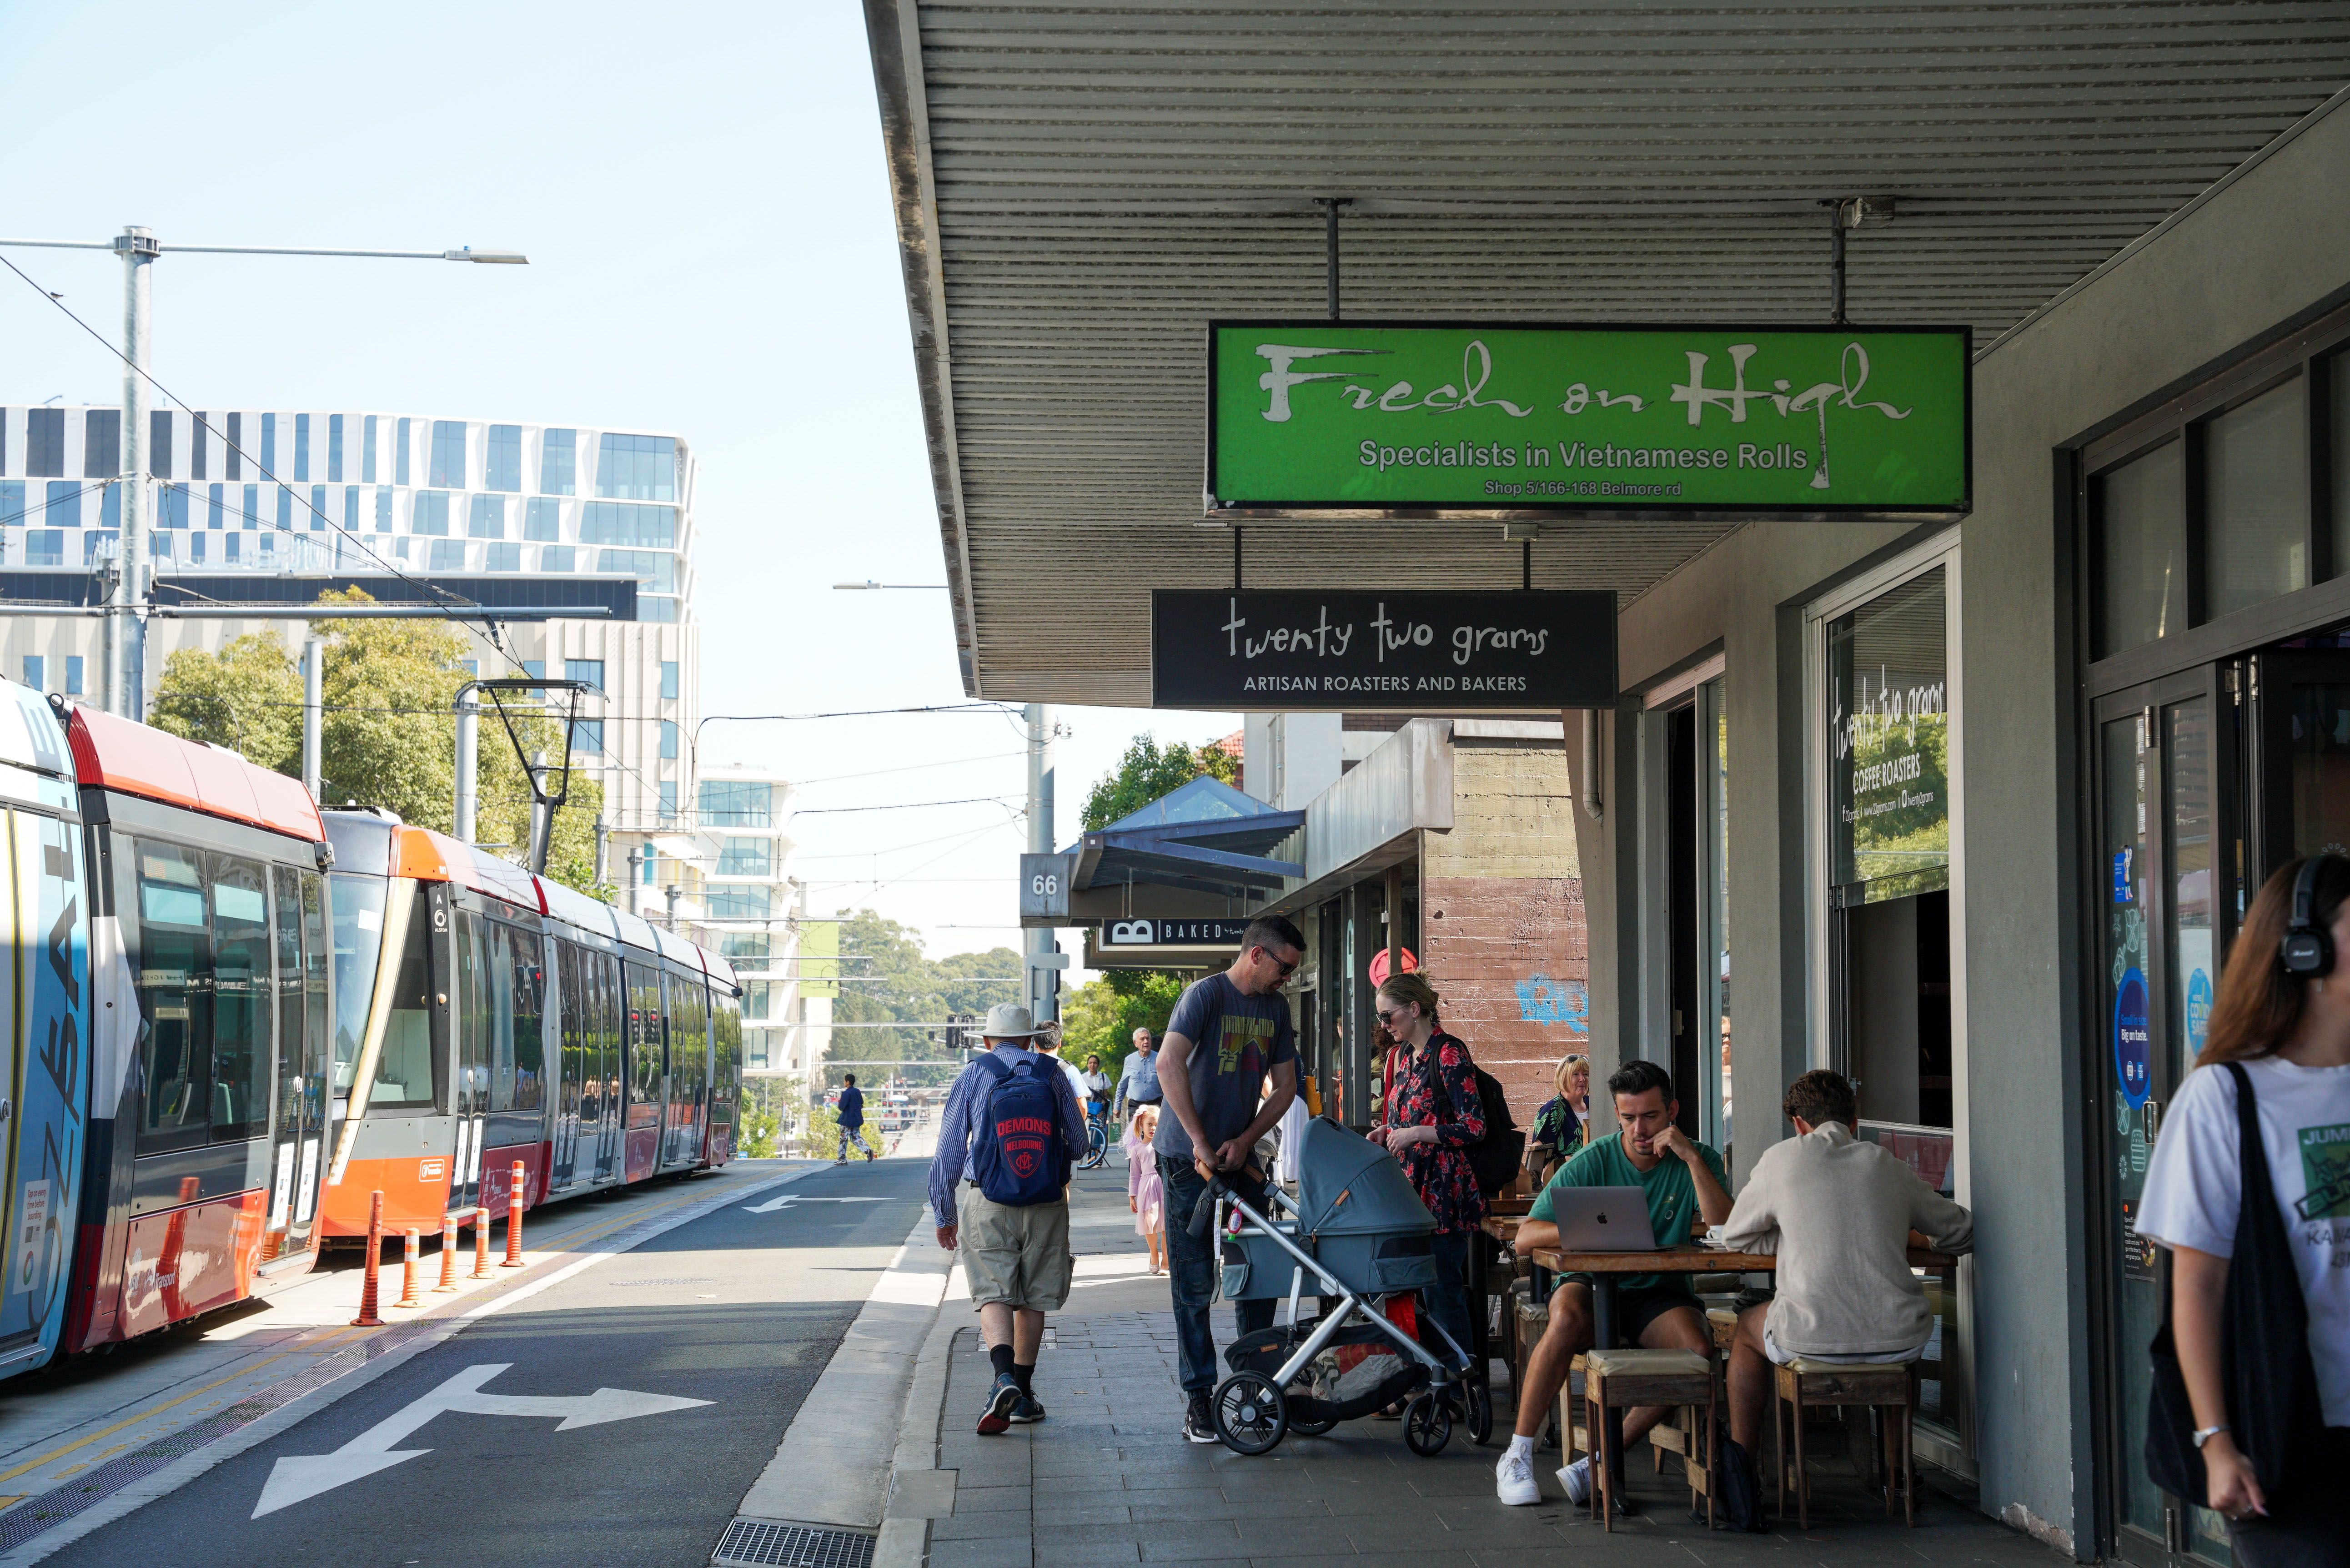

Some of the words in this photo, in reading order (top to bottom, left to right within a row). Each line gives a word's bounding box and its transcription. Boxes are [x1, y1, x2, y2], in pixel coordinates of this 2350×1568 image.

[1557, 382, 1654, 415] on
[1670, 342, 1913, 489] High
[1359, 440, 1517, 472] Specialists
[1526, 441, 1550, 469] in
[1558, 442, 1728, 470] Vietnamese
[1737, 442, 1808, 470] Rolls
[1485, 480, 1522, 497] Shop
[1525, 480, 1597, 494] 5/166-168
[1601, 481, 1662, 496] Belmore
[1666, 481, 1682, 496] rd
[1221, 597, 1353, 659] twenty
[1370, 602, 1434, 663] two
[1452, 625, 1548, 665] grams
[1243, 676, 1316, 691] ARTISAN
[1324, 676, 1410, 691] ROASTERS
[1416, 676, 1455, 691] AND
[1462, 676, 1526, 691] BAKERS
[1833, 676, 1874, 760] twenty
[1879, 663, 1902, 752] two
[1907, 682, 1943, 747] grams
[1853, 764, 1880, 795] COFFEE
[1882, 752, 1920, 787] ROASTERS
[1908, 791, 1933, 807] twenty2grams
[1032, 874, 1057, 895] 66
[436, 894, 442, 904] A
[1165, 925, 1221, 938] BAKED
[2189, 1002, 2211, 1019] COVID
[2121, 1029, 2129, 1043] Big
[2129, 1032, 2135, 1040] on
[2135, 1030, 2148, 1041] taste.
[997, 1117, 1052, 1138] DEMONS
[2303, 1128, 2350, 1145] JUM
[1006, 1140, 1043, 1152] MELBOURNE
[38, 1189, 47, 1198] every
[35, 1199, 45, 1208] before
[28, 1211, 42, 1221] boarding
[155, 1272, 175, 1291] Transport
